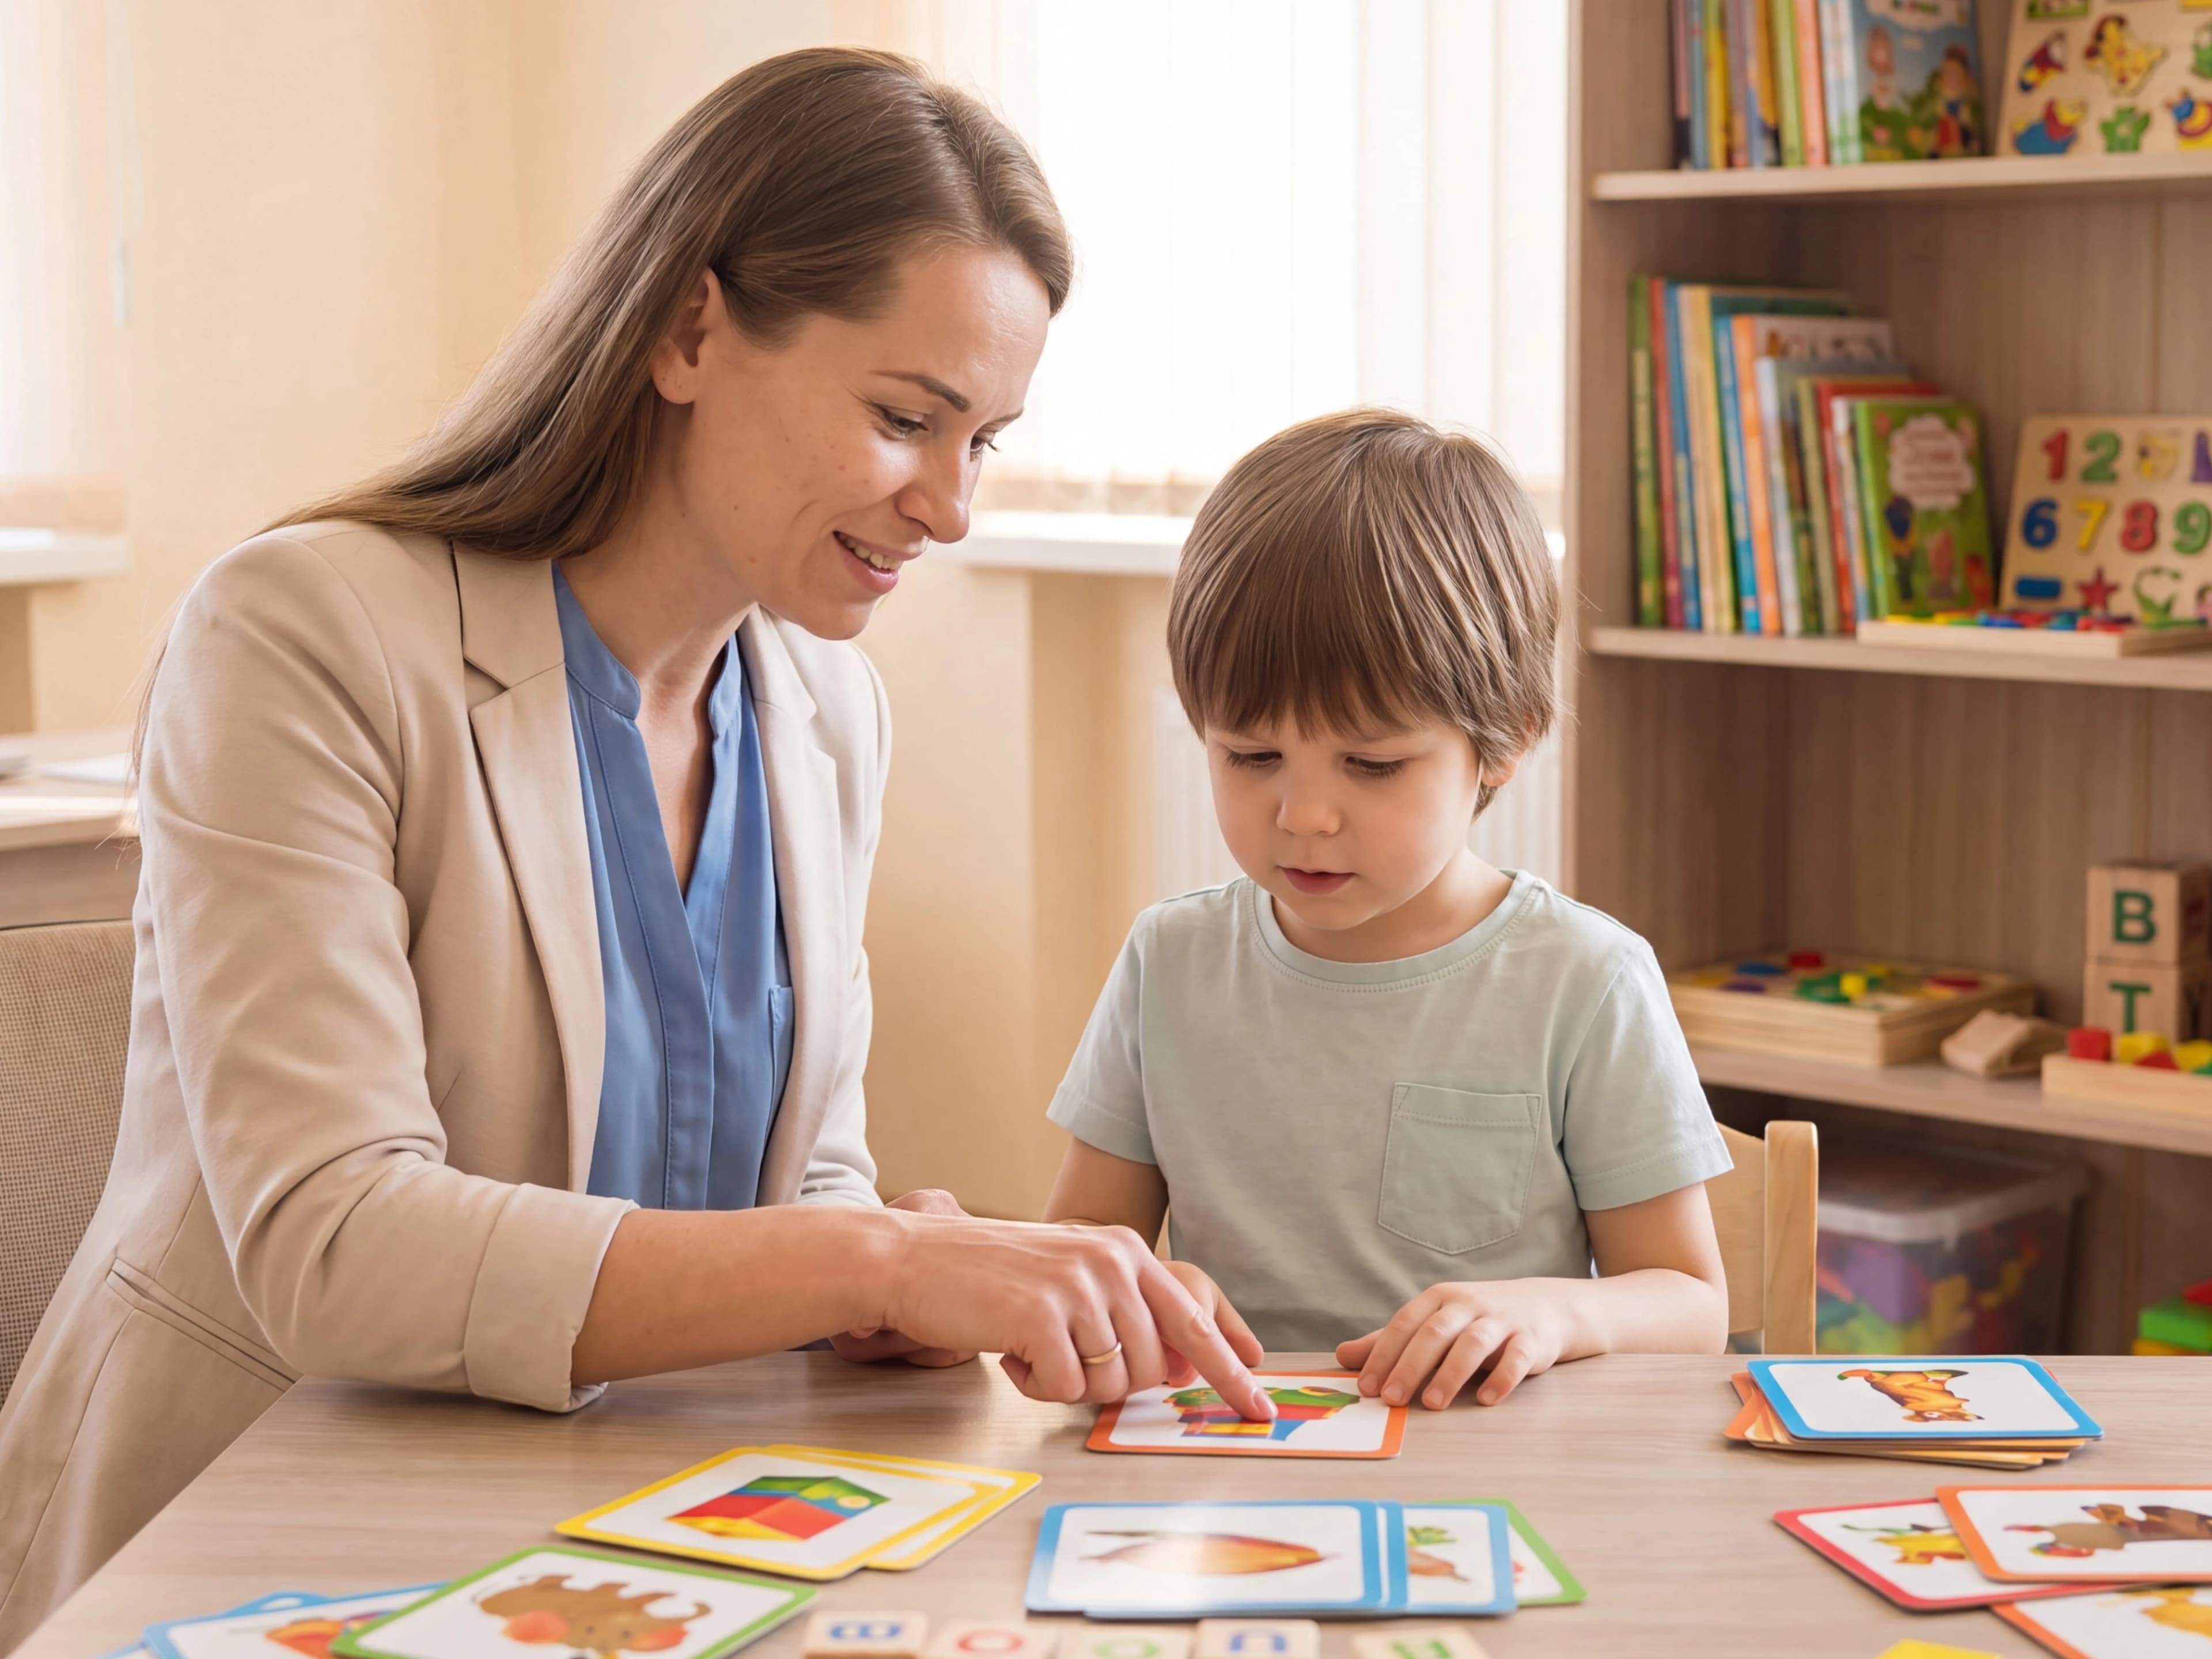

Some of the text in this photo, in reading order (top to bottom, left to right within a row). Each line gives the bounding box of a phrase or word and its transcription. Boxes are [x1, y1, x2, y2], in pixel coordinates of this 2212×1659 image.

[2042, 430, 2120, 483] 1 2
[2022, 498, 2211, 555] 6 7 8 9
[2112, 891, 2156, 945] B
[2109, 982, 2151, 1033] T
